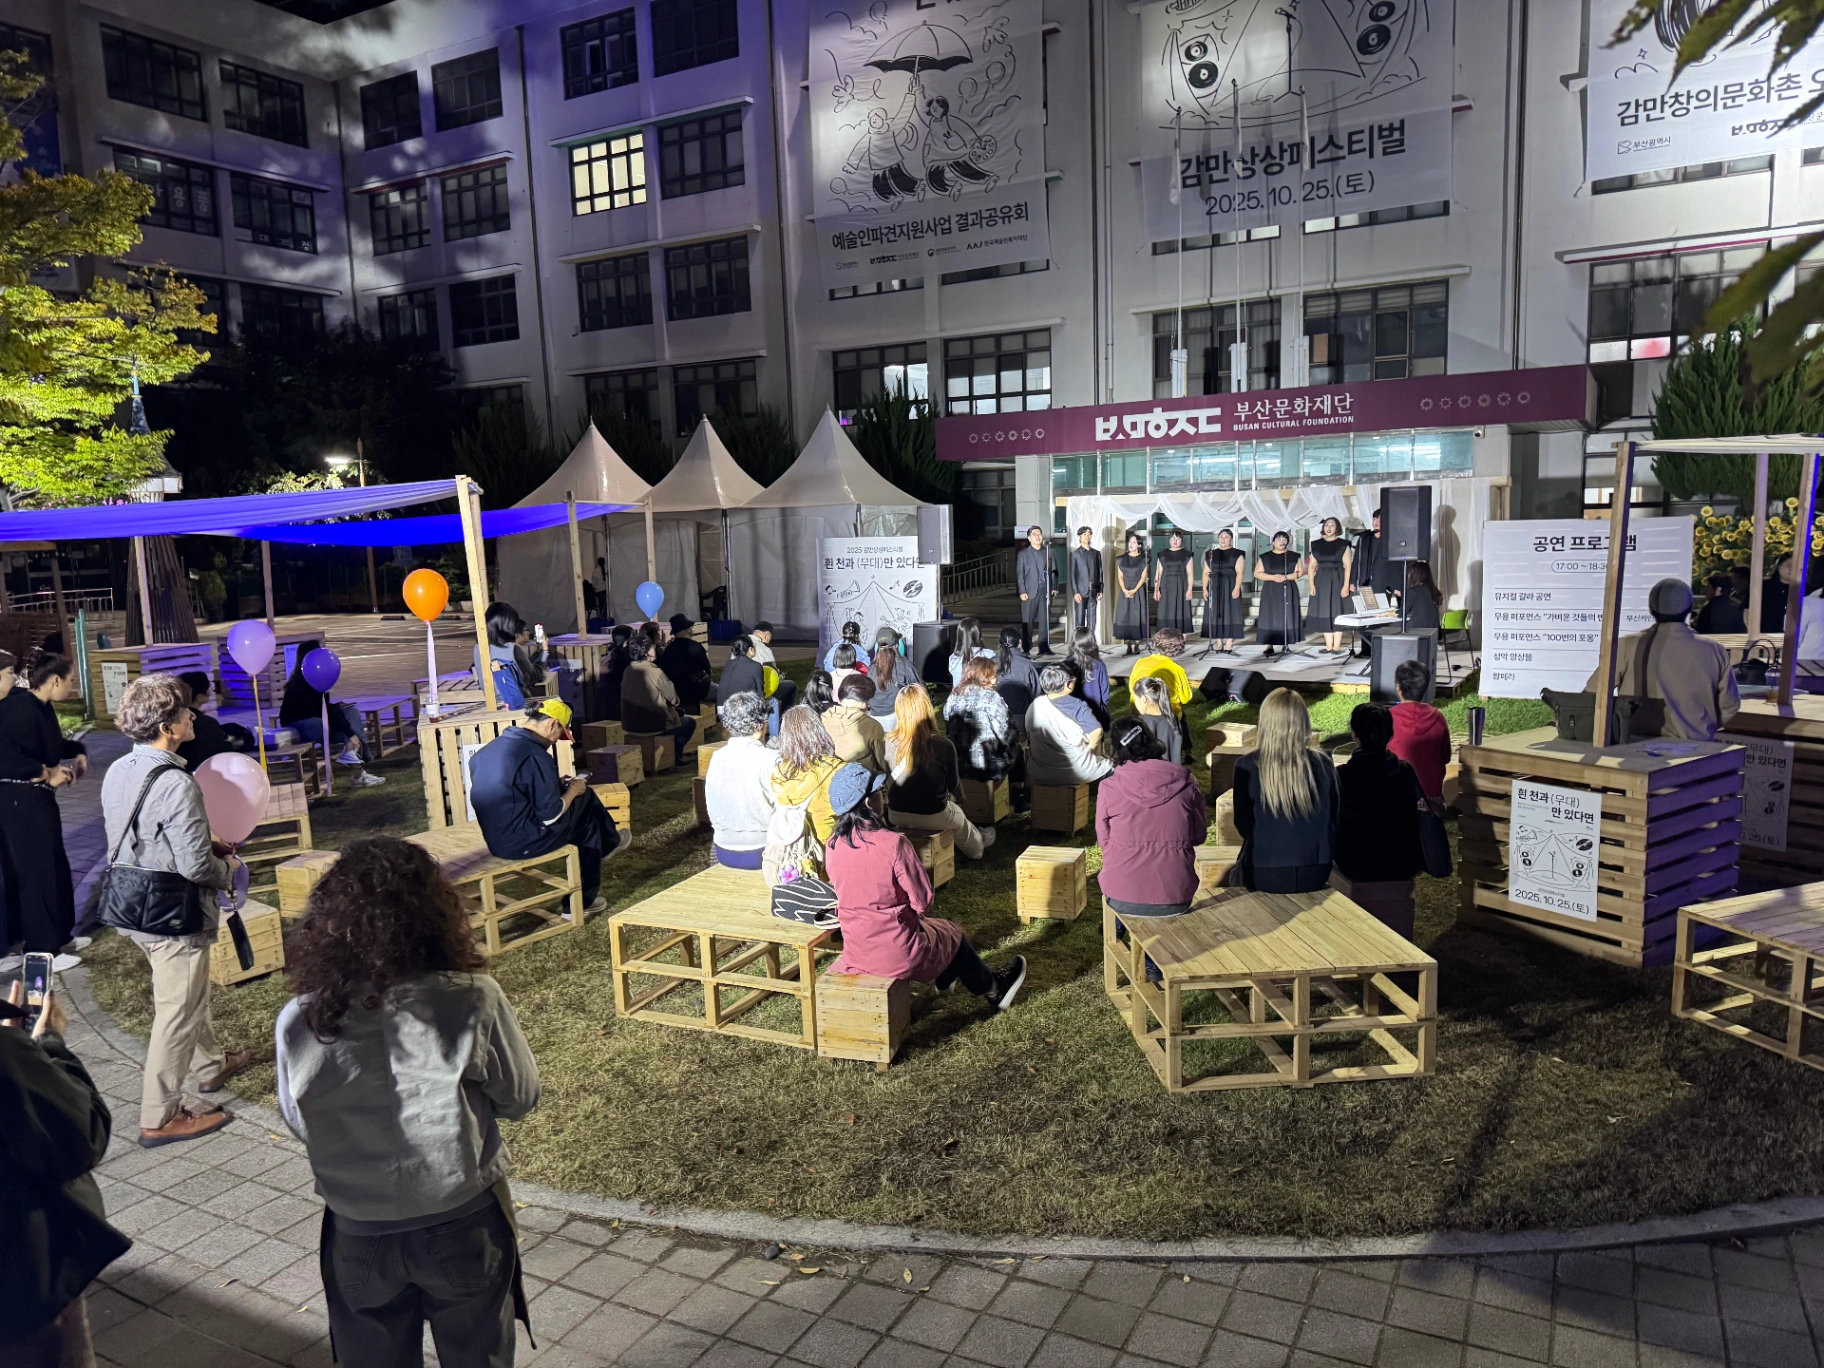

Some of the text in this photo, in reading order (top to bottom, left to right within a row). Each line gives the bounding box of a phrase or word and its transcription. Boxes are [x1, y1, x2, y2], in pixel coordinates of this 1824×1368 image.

[1616, 73, 1802, 126] 감만창의문화촌
[1180, 118, 1406, 188] 감만상상페스티벌
[832, 201, 1029, 251] 예술인파견지원사업 결과공유회
[1234, 393, 1354, 422] 부산문화재단
[1233, 415, 1354, 431] BUSAN CULTURAL FOUNDATION
[846, 546, 862, 554] 2025
[1533, 535, 1566, 552] 공연
[824, 557, 834, 569] 흰
[836, 557, 854, 569] 천과
[857, 556, 893, 569] (무대)만
[1556, 562, 1579, 570] 17:00
[1589, 562, 1607, 570] 18:3
[1494, 592, 1552, 601] 뮤지컬 갈라 공연
[1494, 612, 1509, 621] 무용
[1510, 612, 1541, 621] 퍼포먼스
[1572, 613, 1596, 622] 것들의
[1494, 632, 1509, 641] 무용
[1510, 632, 1541, 642] 퍼포먼스
[1493, 652, 1533, 662] 성악 앙상블
[1758, 756, 1787, 769] 있다면
[1518, 788, 1527, 799] 흰
[1529, 790, 1549, 803] 천과
[1551, 793, 1580, 808] (무대)
[1551, 807, 1561, 818] 만
[1564, 809, 1594, 825] 있다면
